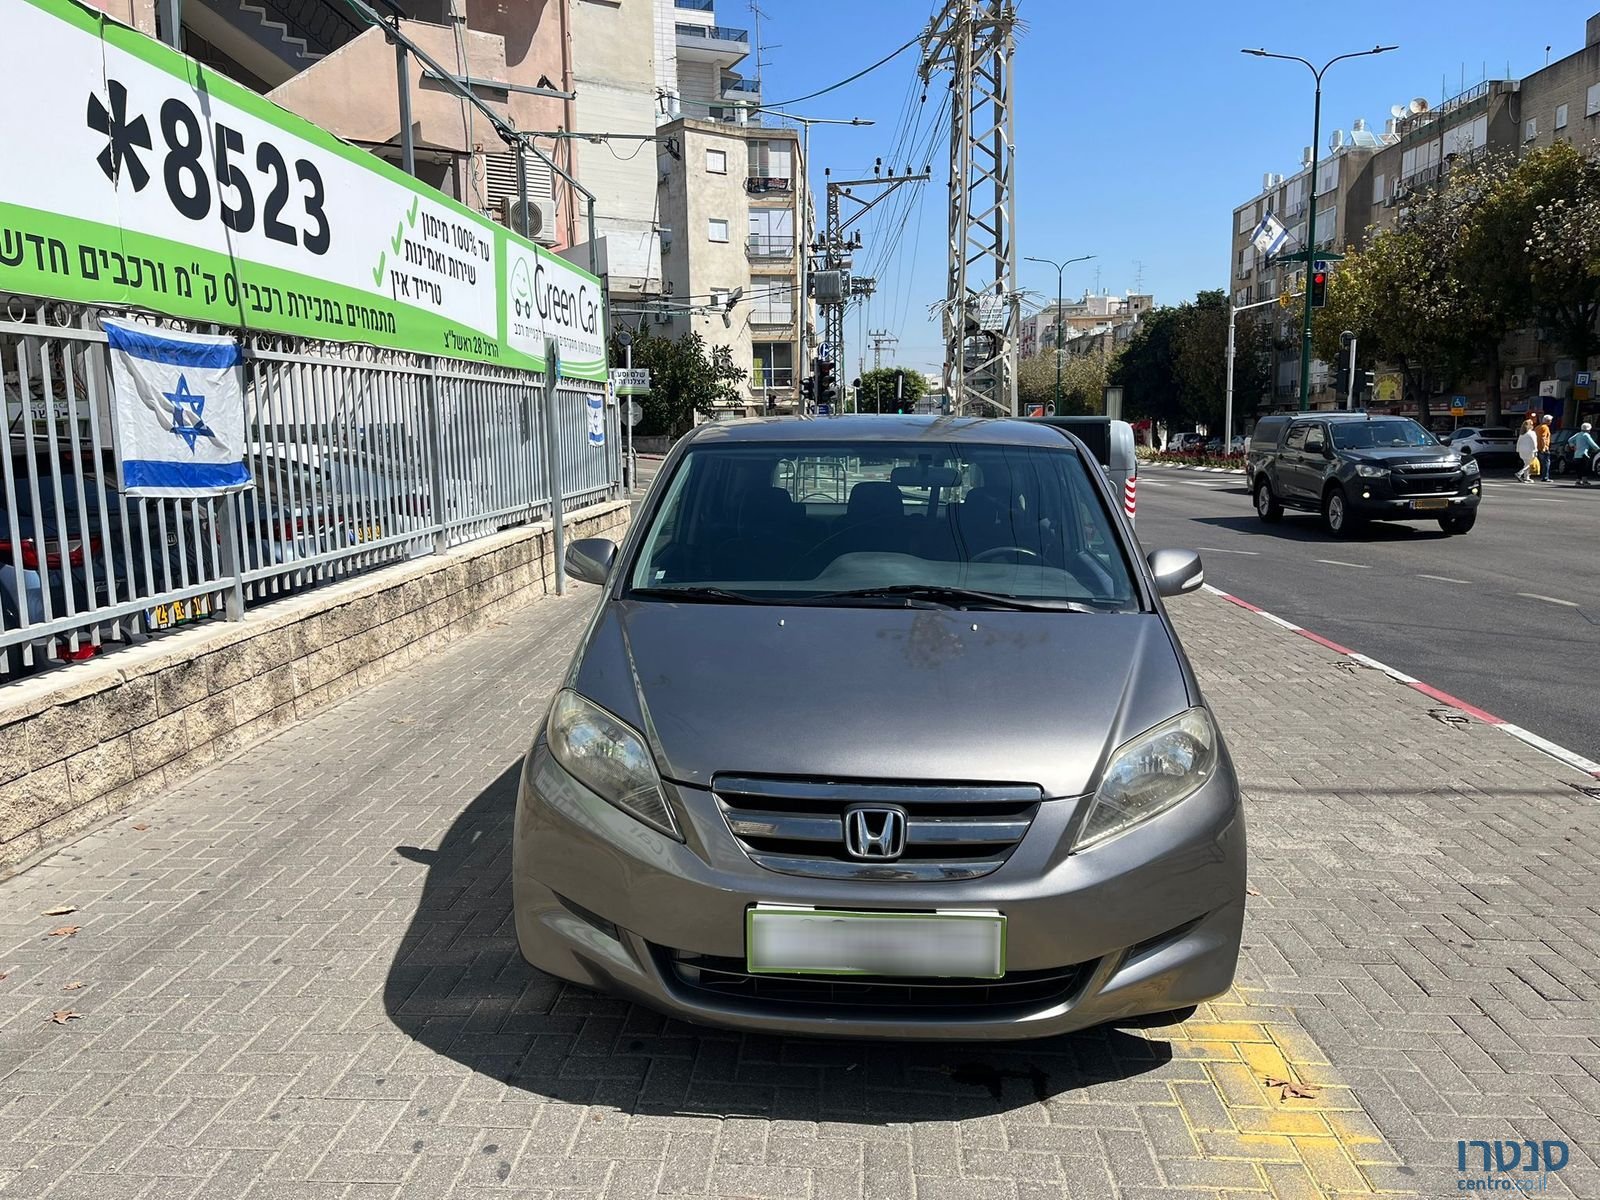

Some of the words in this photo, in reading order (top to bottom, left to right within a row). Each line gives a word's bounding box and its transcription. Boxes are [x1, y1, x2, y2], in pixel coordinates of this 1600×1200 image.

[421, 211, 449, 244] מימון
[451, 224, 478, 257] 100%
[404, 238, 446, 275] ואמינות
[478, 240, 490, 262] עד
[79, 244, 167, 293] ורכבים
[174, 262, 217, 305] ק"מ
[390, 269, 409, 301] אין
[449, 256, 476, 286] שירות
[224, 272, 238, 307] 0
[243, 282, 284, 315] רכבי
[412, 276, 442, 306] טרייד
[534, 263, 578, 329] Green
[579, 284, 598, 336] Car
[286, 291, 344, 326] במכירת
[345, 303, 397, 334] מתמחים
[443, 329, 473, 353] ראשל"צ
[473, 336, 483, 355] 28
[483, 337, 499, 358] הרצל
